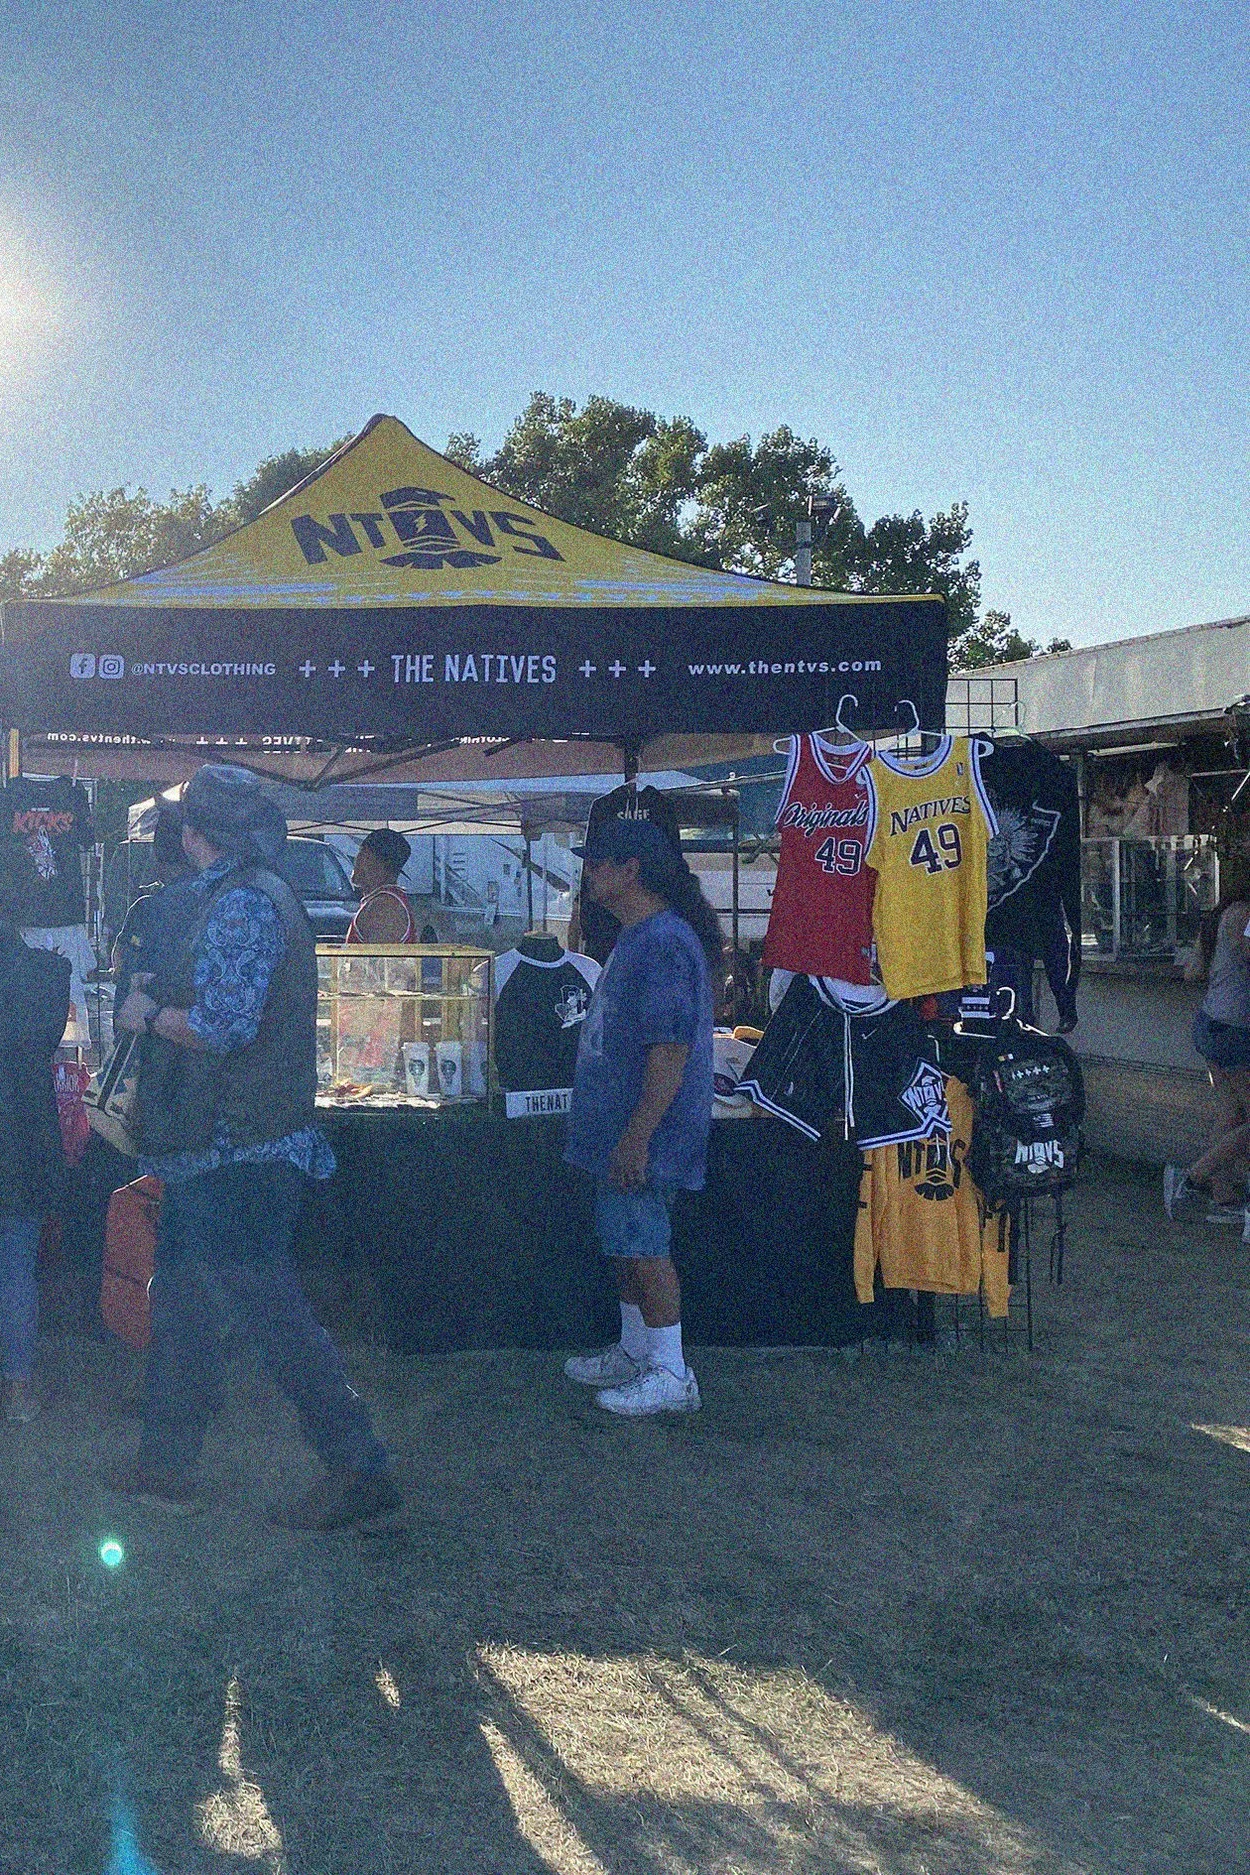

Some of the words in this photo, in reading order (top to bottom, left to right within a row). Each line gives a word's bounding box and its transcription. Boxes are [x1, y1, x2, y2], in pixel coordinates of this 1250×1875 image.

[131, 662, 276, 677] @NTVSCLOTHING
[391, 654, 434, 683] THE
[445, 654, 556, 683] NATIVES
[688, 659, 882, 676] www.thentvs.com
[890, 795, 971, 837] NATIVES
[815, 836, 862, 876] 49
[910, 822, 963, 875] 49
